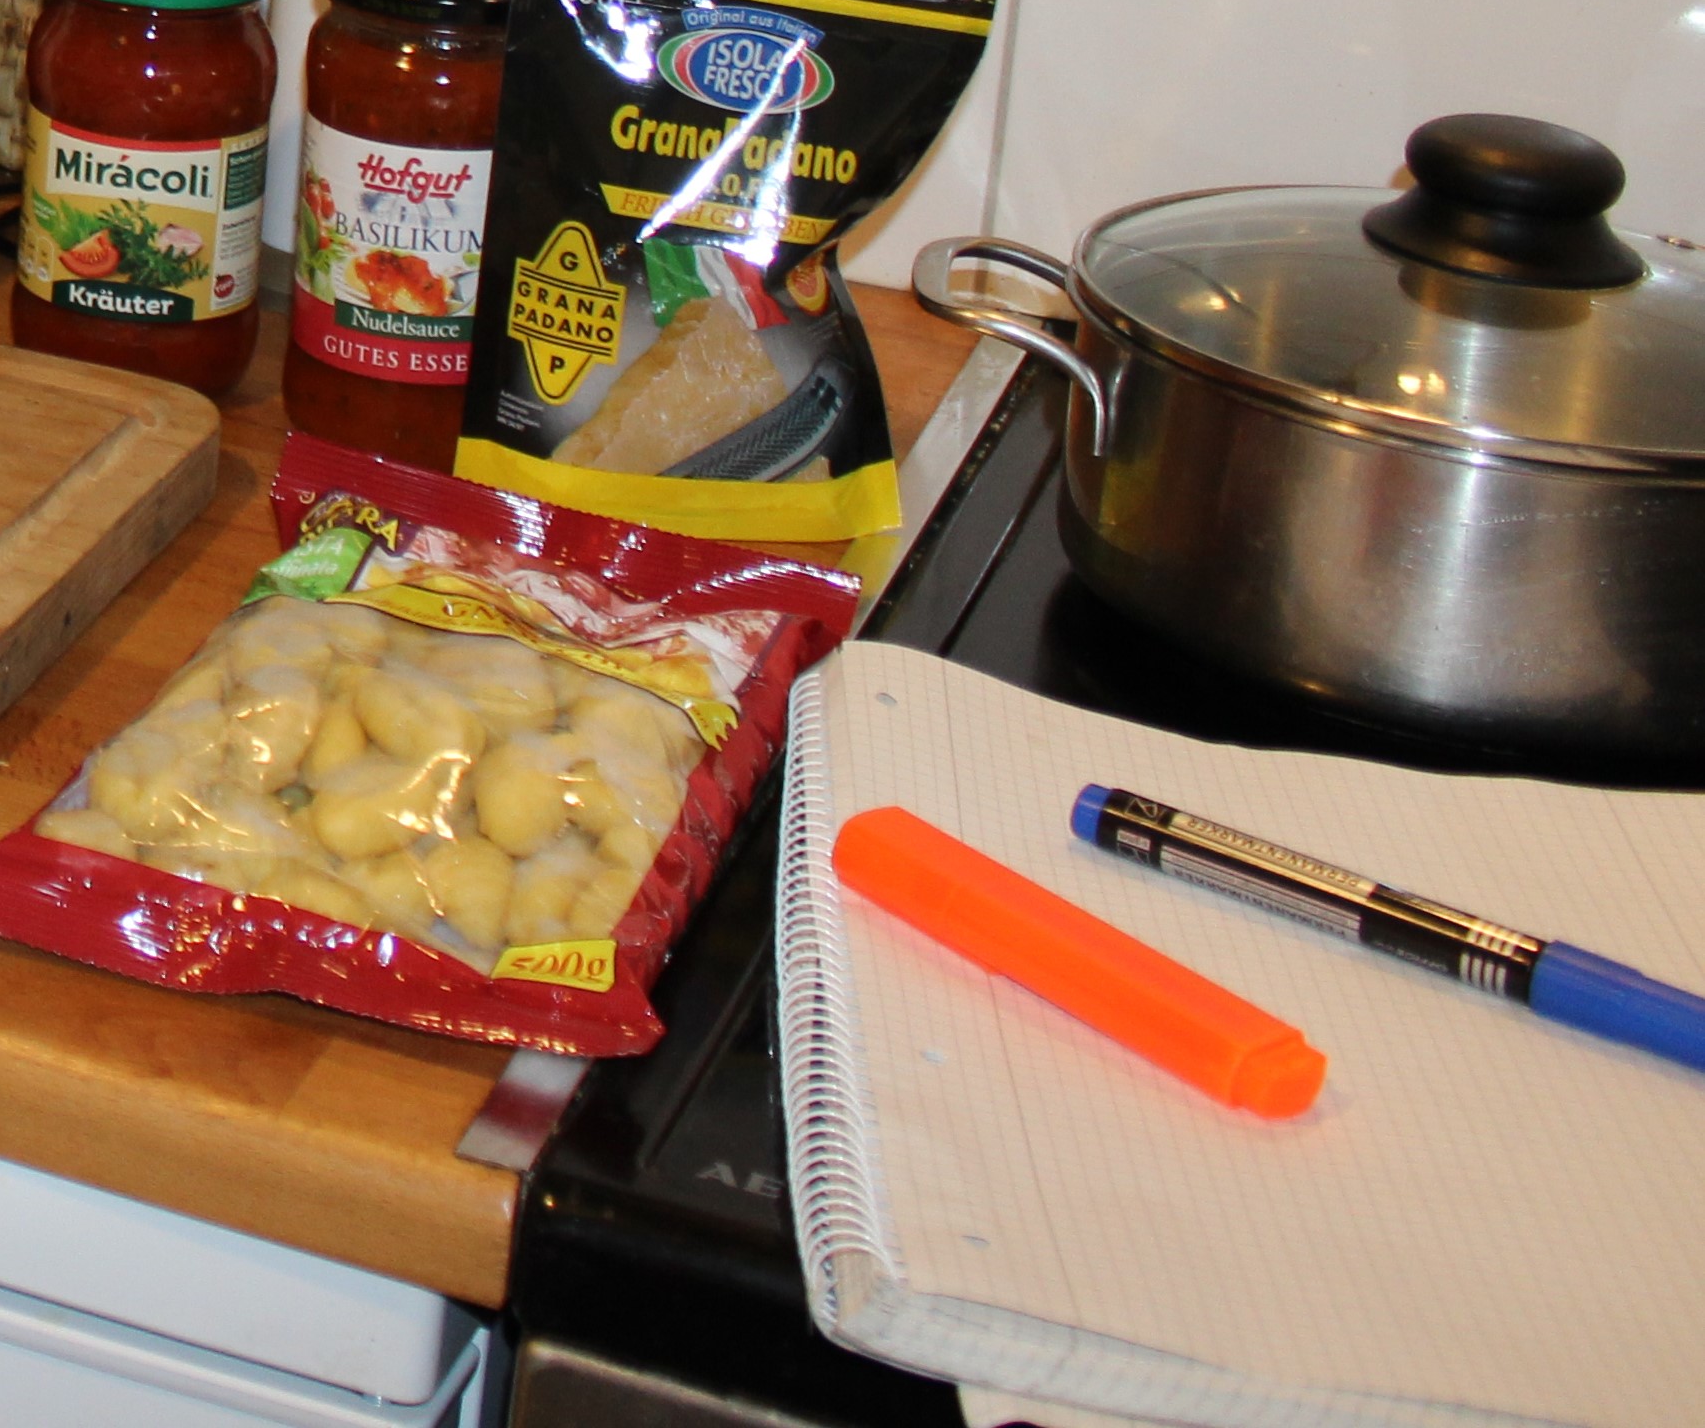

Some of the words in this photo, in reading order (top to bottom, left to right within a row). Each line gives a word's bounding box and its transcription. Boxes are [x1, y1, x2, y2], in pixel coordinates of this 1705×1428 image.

[686, 11, 744, 31] Original
[749, 15, 773, 29] aus
[707, 41, 786, 73] ISOLA
[703, 65, 785, 101] FRESCA
[55, 149, 210, 199] Mirácoli
[357, 153, 474, 204] Hofgut
[559, 251, 579, 272] G
[67, 283, 175, 316] Kräuter
[517, 281, 616, 321] GRANA
[350, 306, 461, 339] Nudelsauce
[514, 303, 614, 343] PADANO
[322, 334, 400, 369] GUTES
[409, 353, 469, 373] ESSE
[549, 355, 566, 375] P
[695, 1160, 783, 1199] AE
